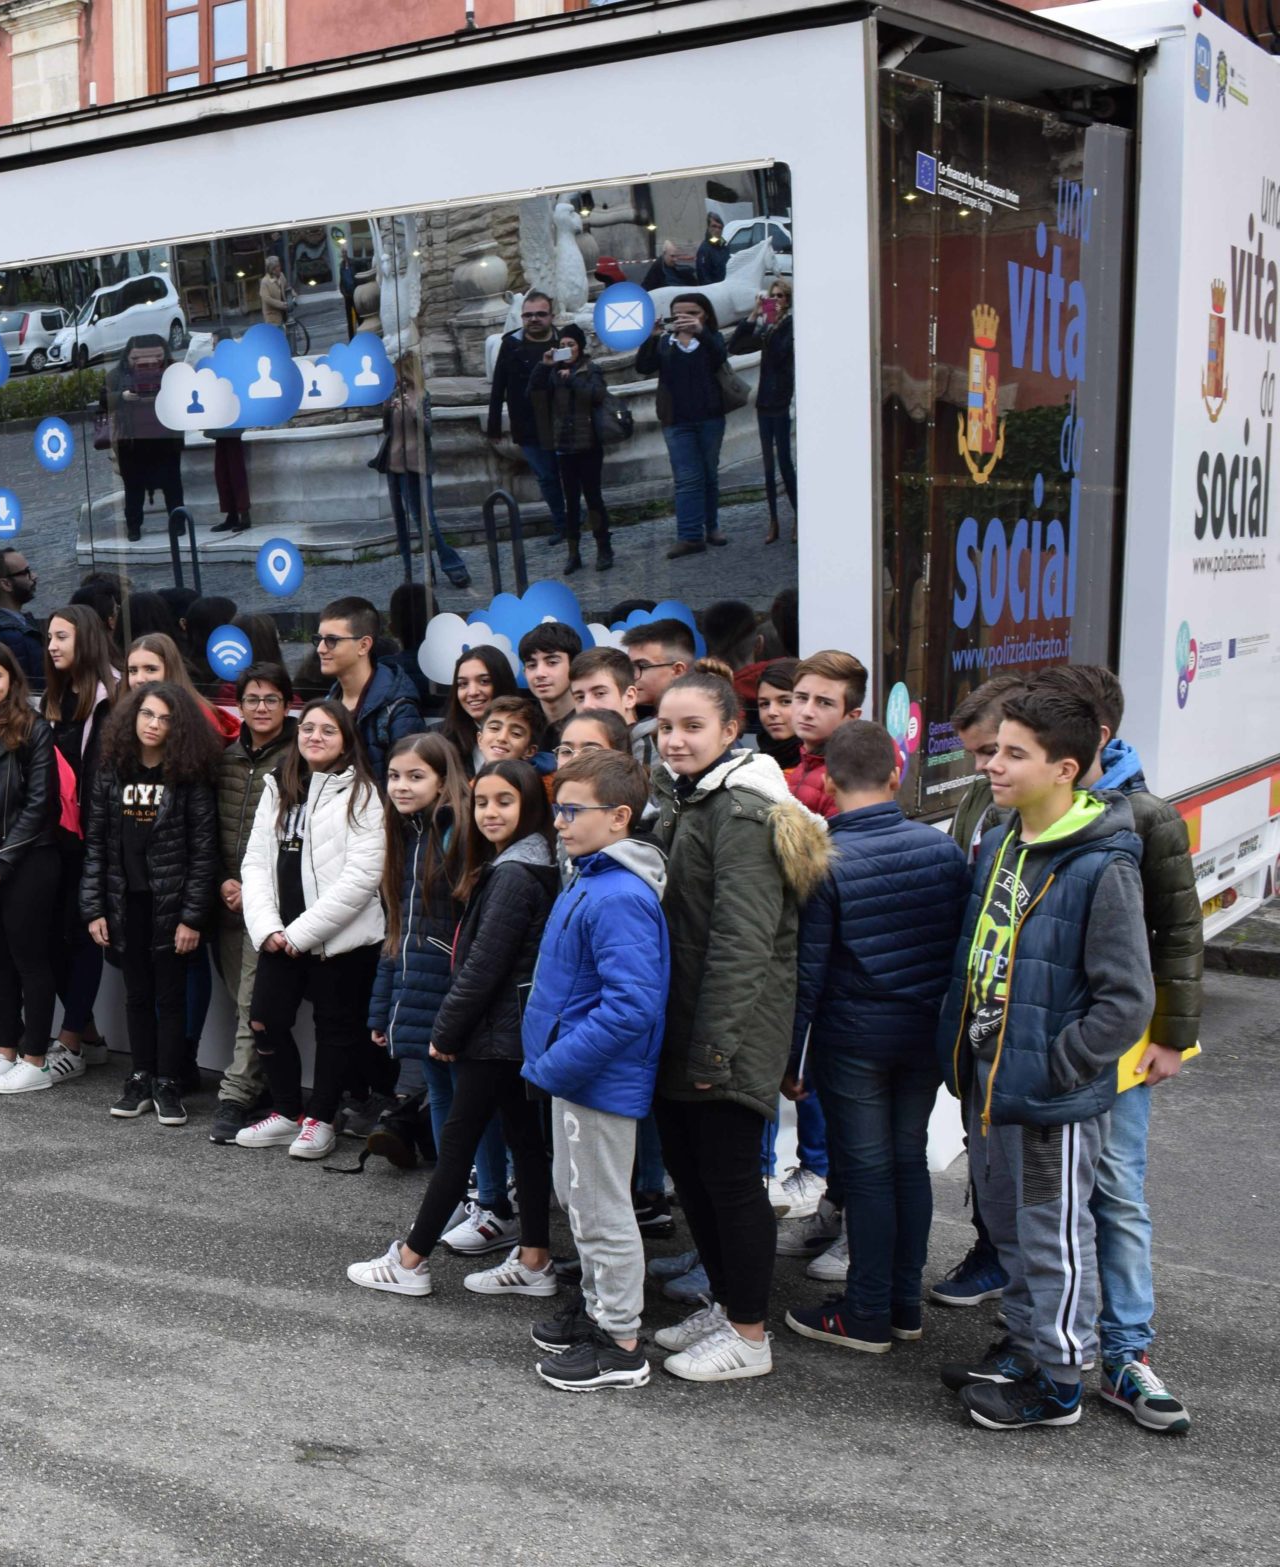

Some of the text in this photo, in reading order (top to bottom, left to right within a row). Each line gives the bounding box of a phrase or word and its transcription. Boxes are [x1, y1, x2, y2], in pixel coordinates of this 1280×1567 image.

[967, 172, 975, 189] by
[974, 176, 983, 190] the
[983, 179, 1006, 198] European
[1005, 188, 1020, 204] Union
[1057, 176, 1093, 244] una
[1007, 220, 1088, 382] vita
[1230, 212, 1278, 344] vita
[1260, 349, 1275, 418] da
[1060, 389, 1085, 473] da
[1194, 417, 1272, 541] social
[953, 473, 1080, 629] social
[1192, 548, 1266, 581] www.poliziadistato.it
[952, 629, 1073, 677] www.poliziadistato.it
[1003, 875, 1029, 908] ERY
